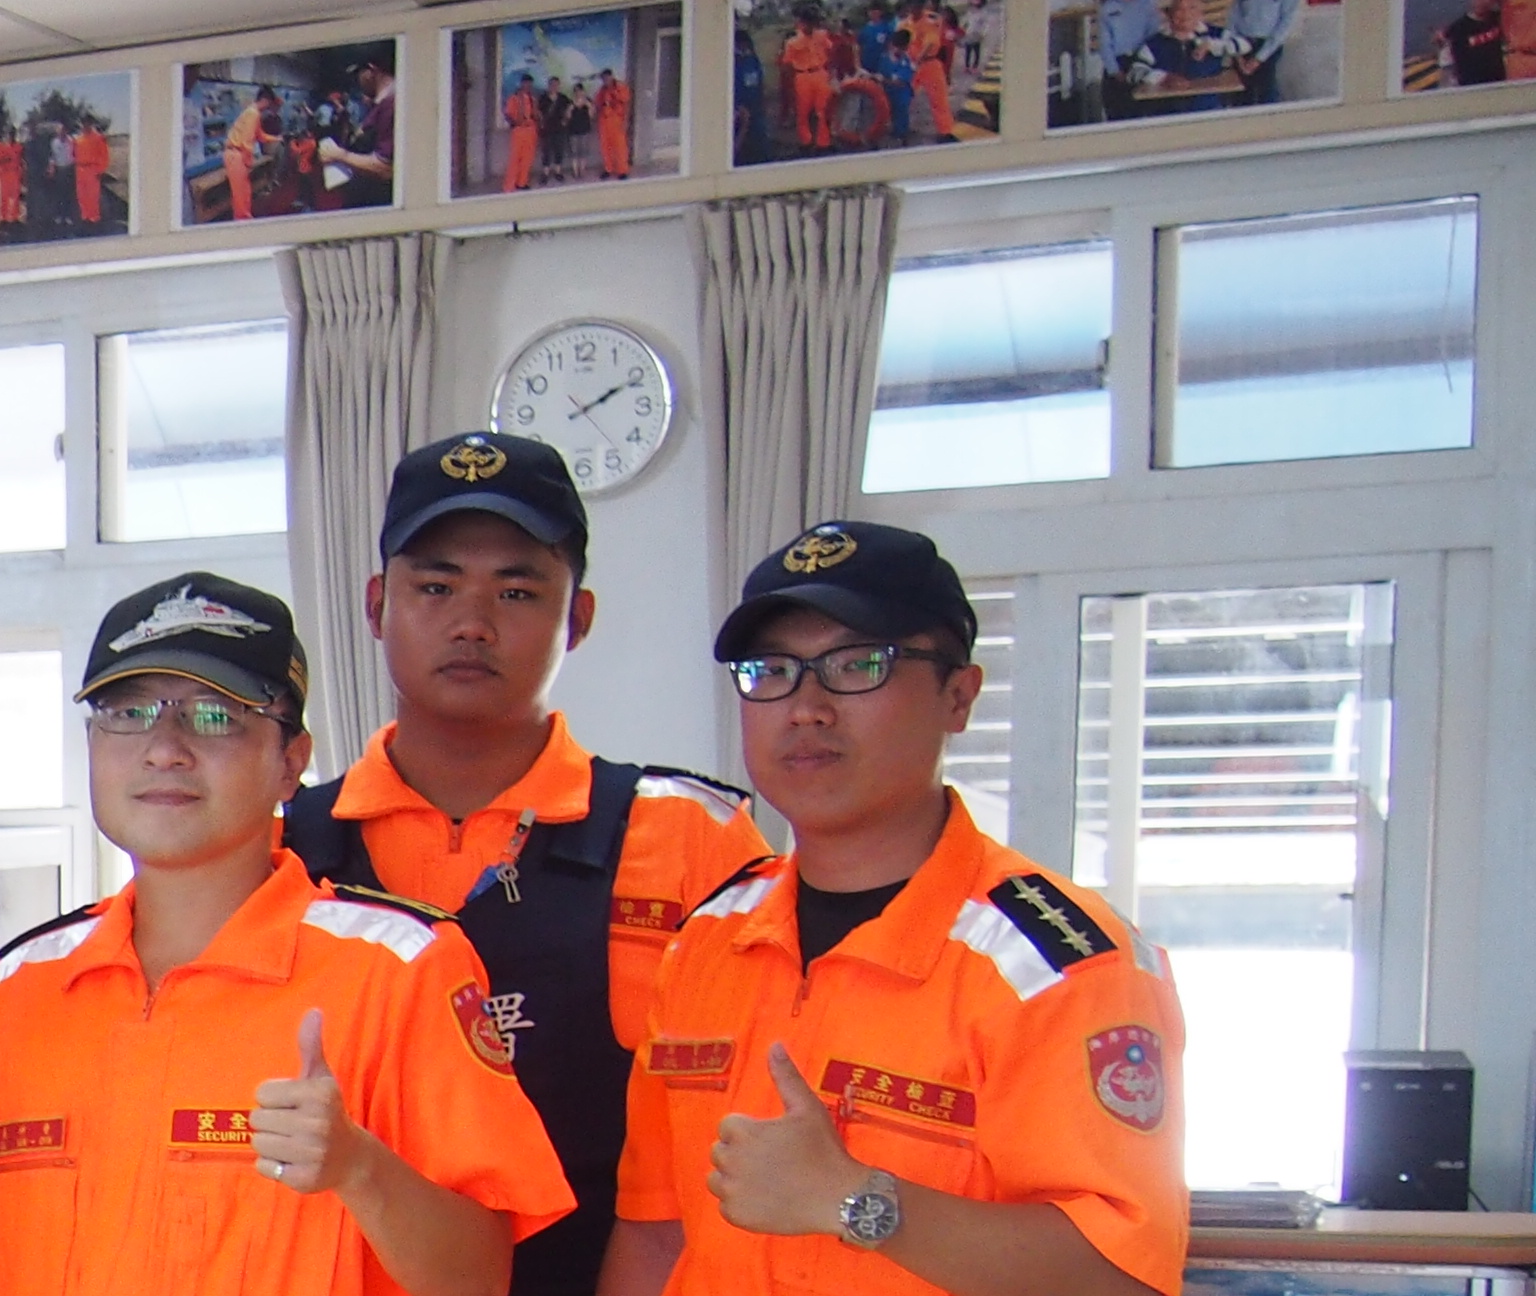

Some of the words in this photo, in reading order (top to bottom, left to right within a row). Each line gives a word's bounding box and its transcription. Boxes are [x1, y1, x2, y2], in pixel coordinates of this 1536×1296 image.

[544, 346, 563, 372] 11
[574, 341, 597, 362] 12
[628, 366, 645, 388] 2
[517, 404, 535, 426] 9
[634, 395, 652, 417] 3
[625, 426, 641, 445] 4
[574, 457, 593, 478] 6
[197, 1111, 250, 1131] 安全
